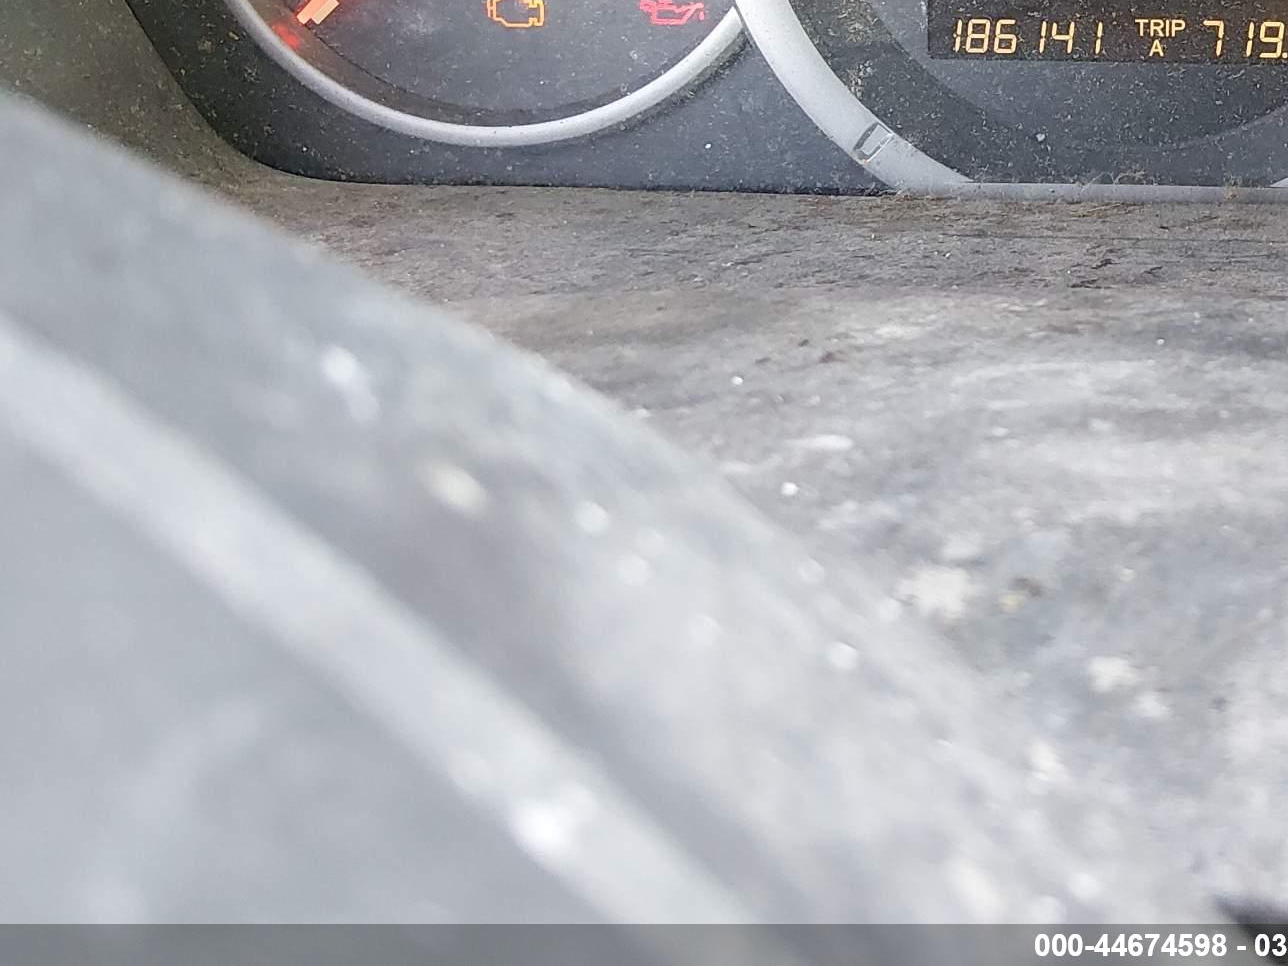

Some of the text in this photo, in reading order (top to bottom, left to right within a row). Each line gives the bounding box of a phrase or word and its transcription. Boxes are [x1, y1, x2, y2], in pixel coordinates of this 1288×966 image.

[954, 19, 1103, 54] 186141
[1135, 19, 1186, 37] TRIP
[1149, 39, 1164, 57] A
